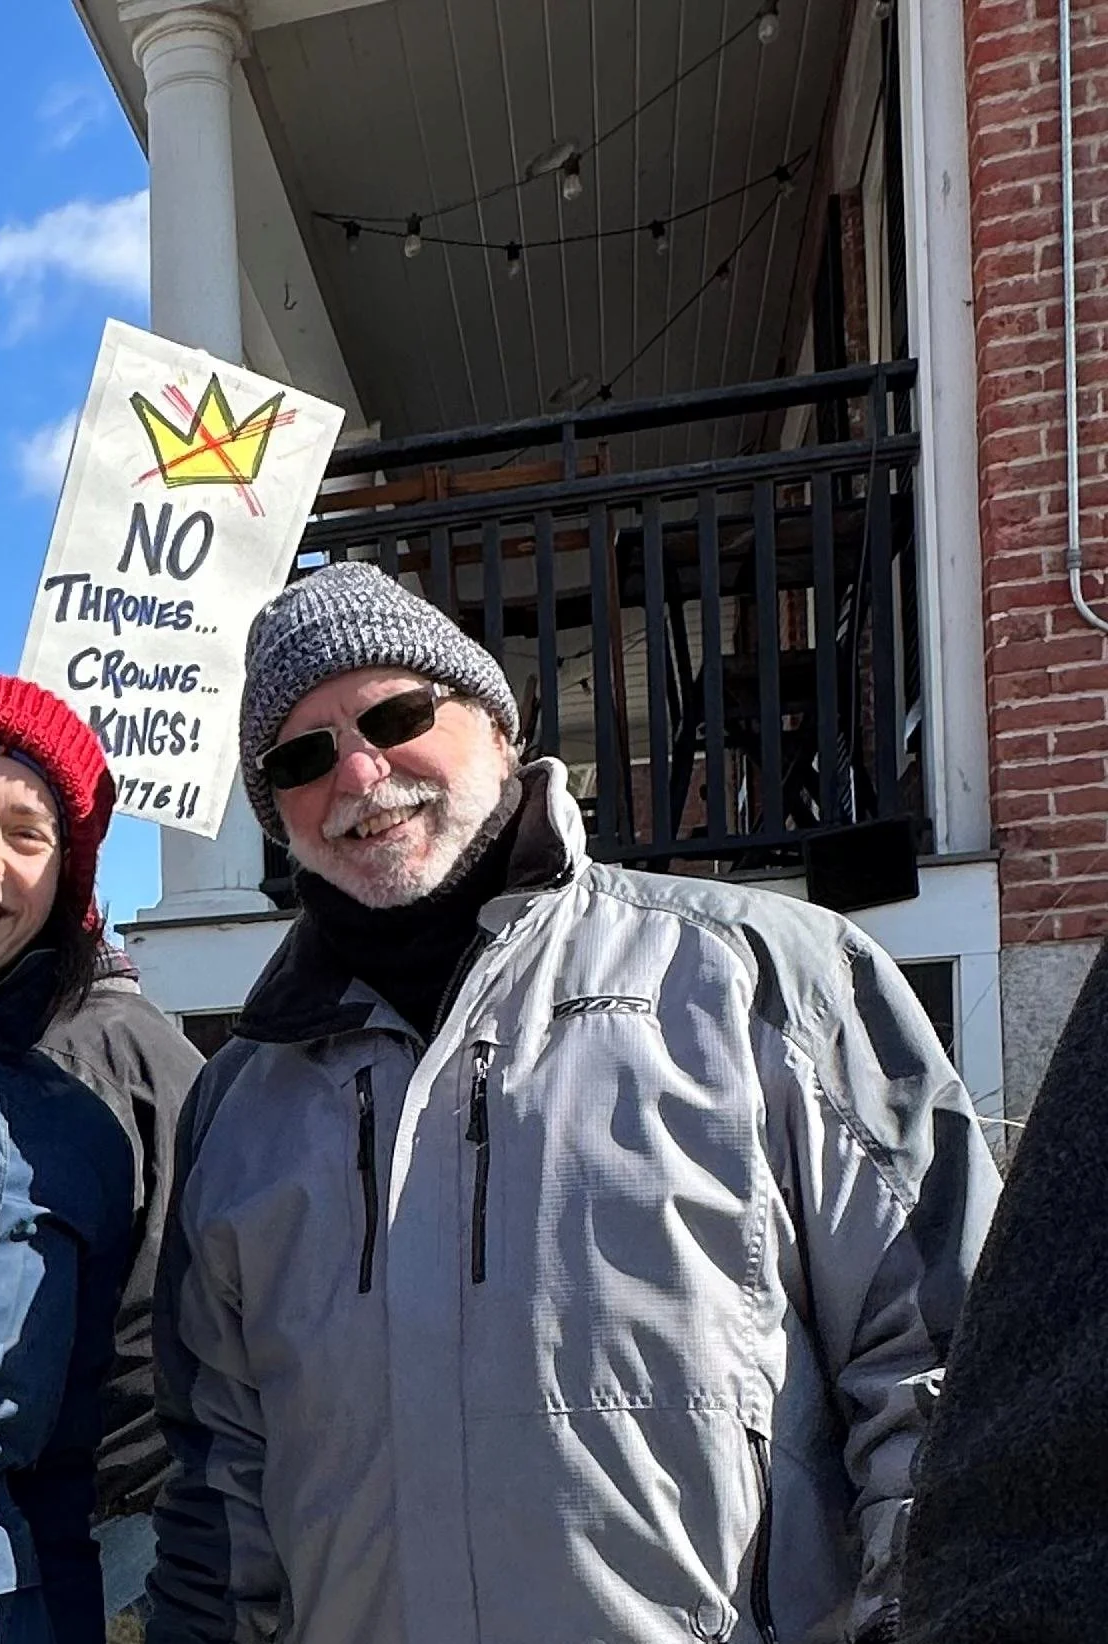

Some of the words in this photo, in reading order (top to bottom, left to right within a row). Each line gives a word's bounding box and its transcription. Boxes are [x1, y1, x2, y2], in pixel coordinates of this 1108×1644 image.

[117, 502, 214, 581] NO
[44, 573, 218, 636] THRONES...
[68, 646, 219, 698] CROWNS...
[89, 705, 201, 758] KINGS!
